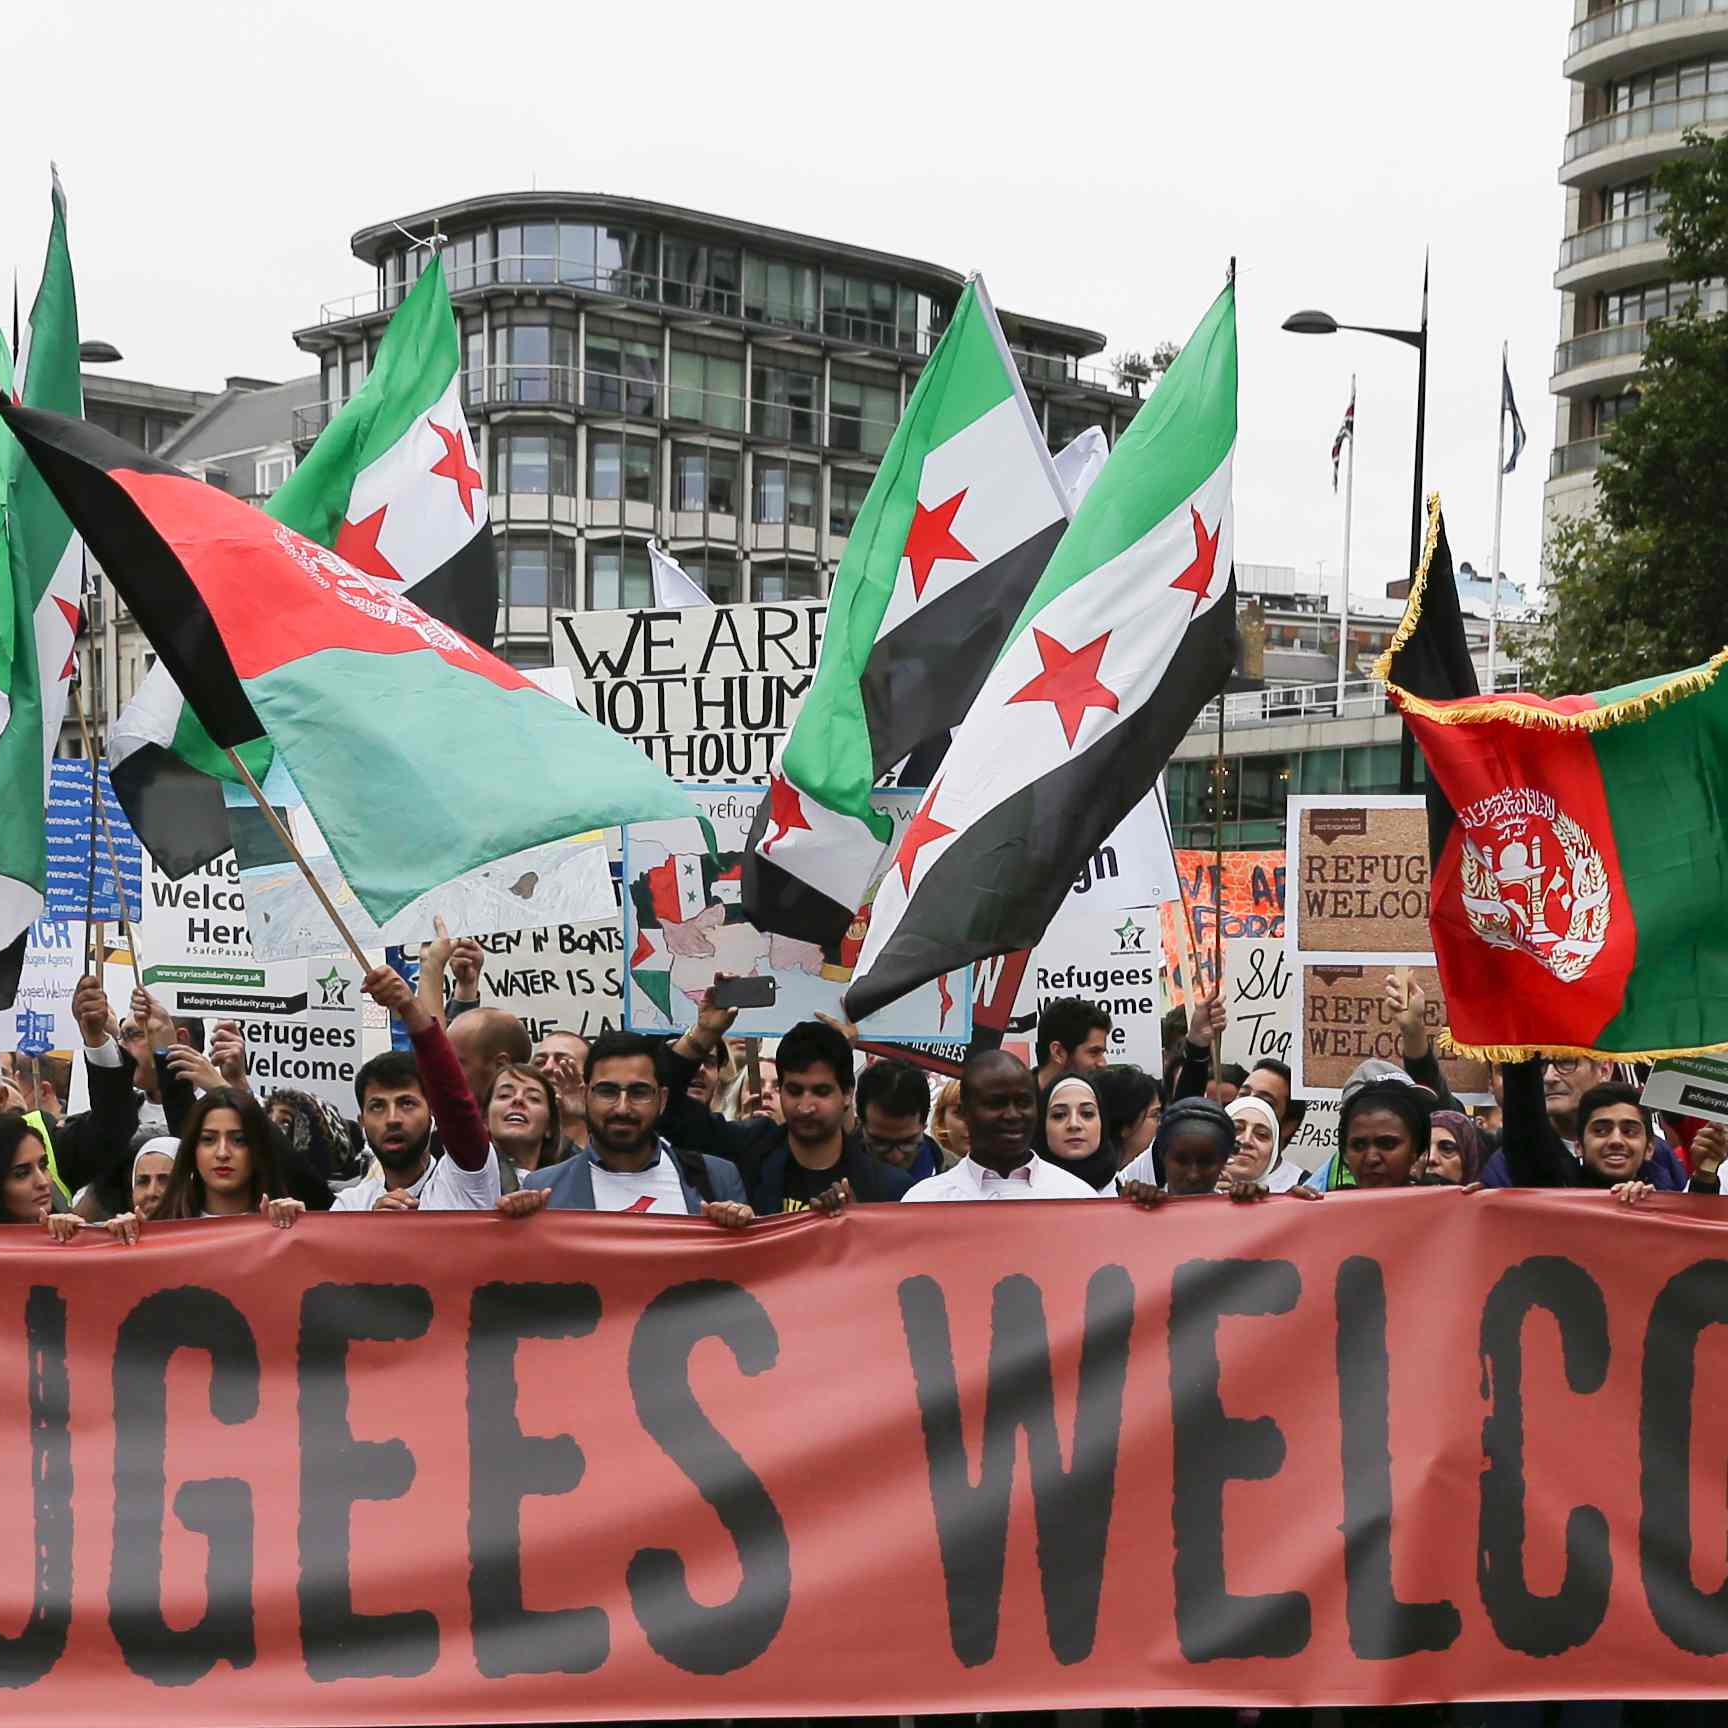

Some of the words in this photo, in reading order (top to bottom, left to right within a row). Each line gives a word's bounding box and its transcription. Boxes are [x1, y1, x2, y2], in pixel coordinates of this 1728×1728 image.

[555, 609, 687, 679] WE
[693, 674, 813, 732] HUM
[1306, 854, 1429, 885] REFUG
[151, 882, 244, 911] Welco
[1305, 889, 1432, 919] WELCO
[156, 968, 262, 984] www.syriasolidarity.org.uk
[483, 968, 560, 998] WATER
[566, 967, 595, 997] IS
[1037, 964, 1154, 994] Refugees
